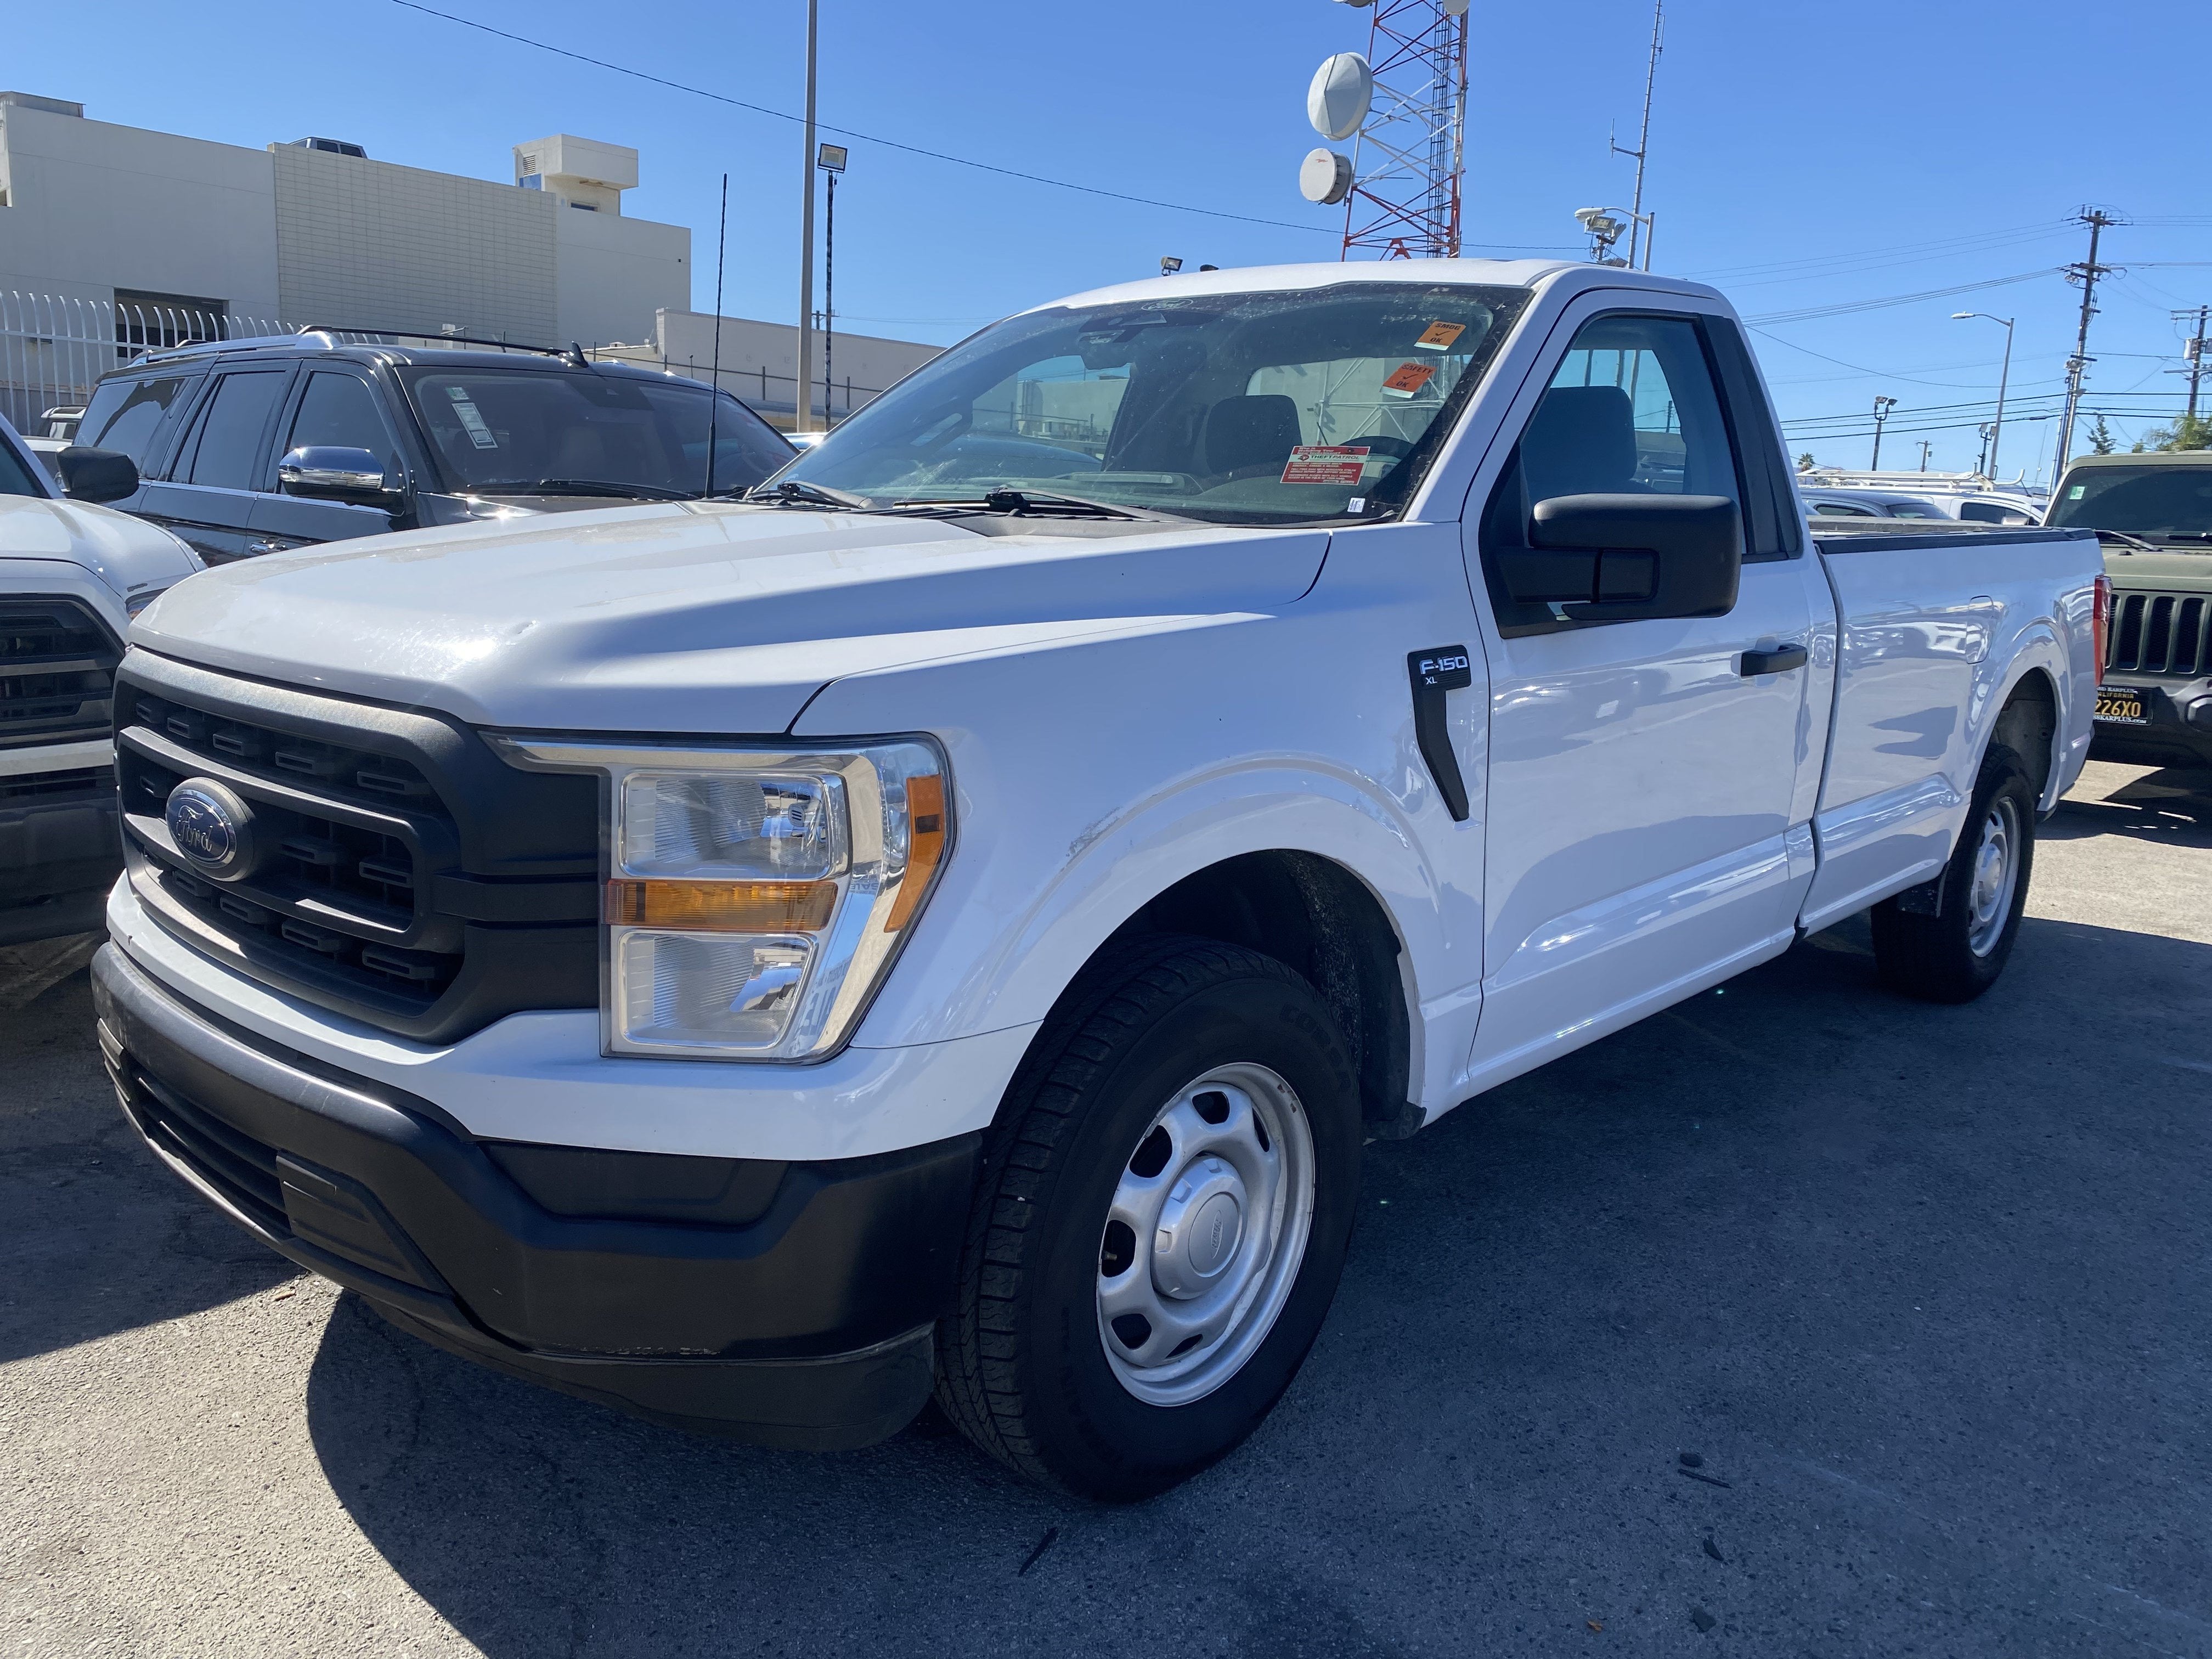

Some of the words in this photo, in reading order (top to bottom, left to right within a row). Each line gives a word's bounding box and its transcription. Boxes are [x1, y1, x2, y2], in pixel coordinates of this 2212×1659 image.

[1401, 364, 1433, 374] SAFETY
[1419, 656, 1468, 675] F-150
[1425, 676, 1437, 685] XL
[176, 805, 212, 852] Ford
